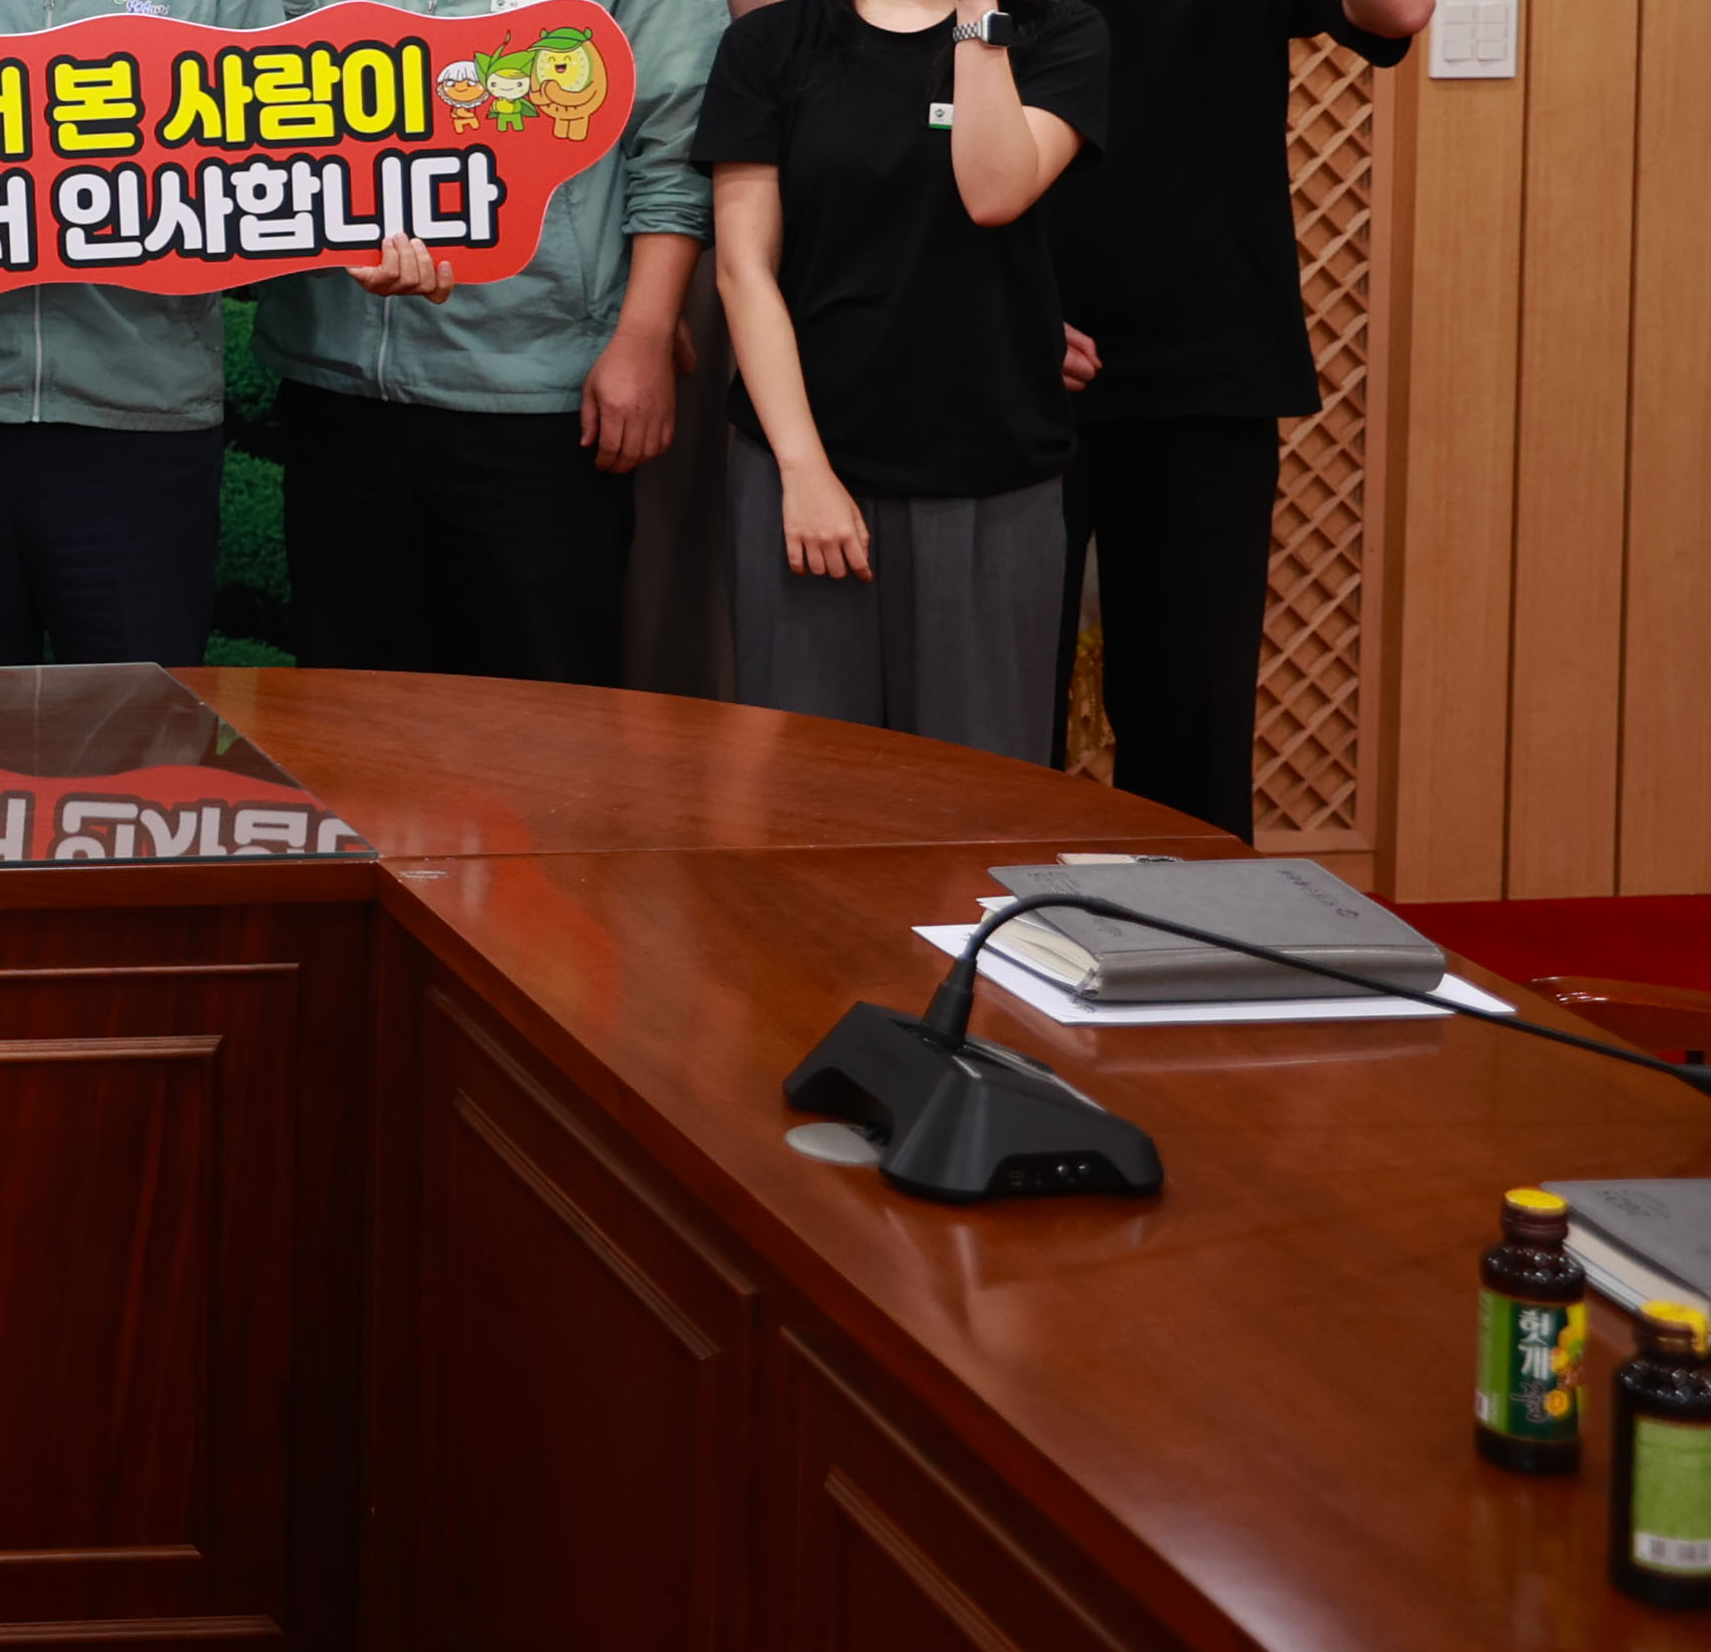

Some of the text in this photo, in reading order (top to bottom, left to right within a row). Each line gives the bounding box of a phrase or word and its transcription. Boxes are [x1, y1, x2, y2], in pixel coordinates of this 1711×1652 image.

[52, 59, 139, 152] 본
[162, 43, 426, 144] 사람이
[57, 151, 499, 262] 인사합니다
